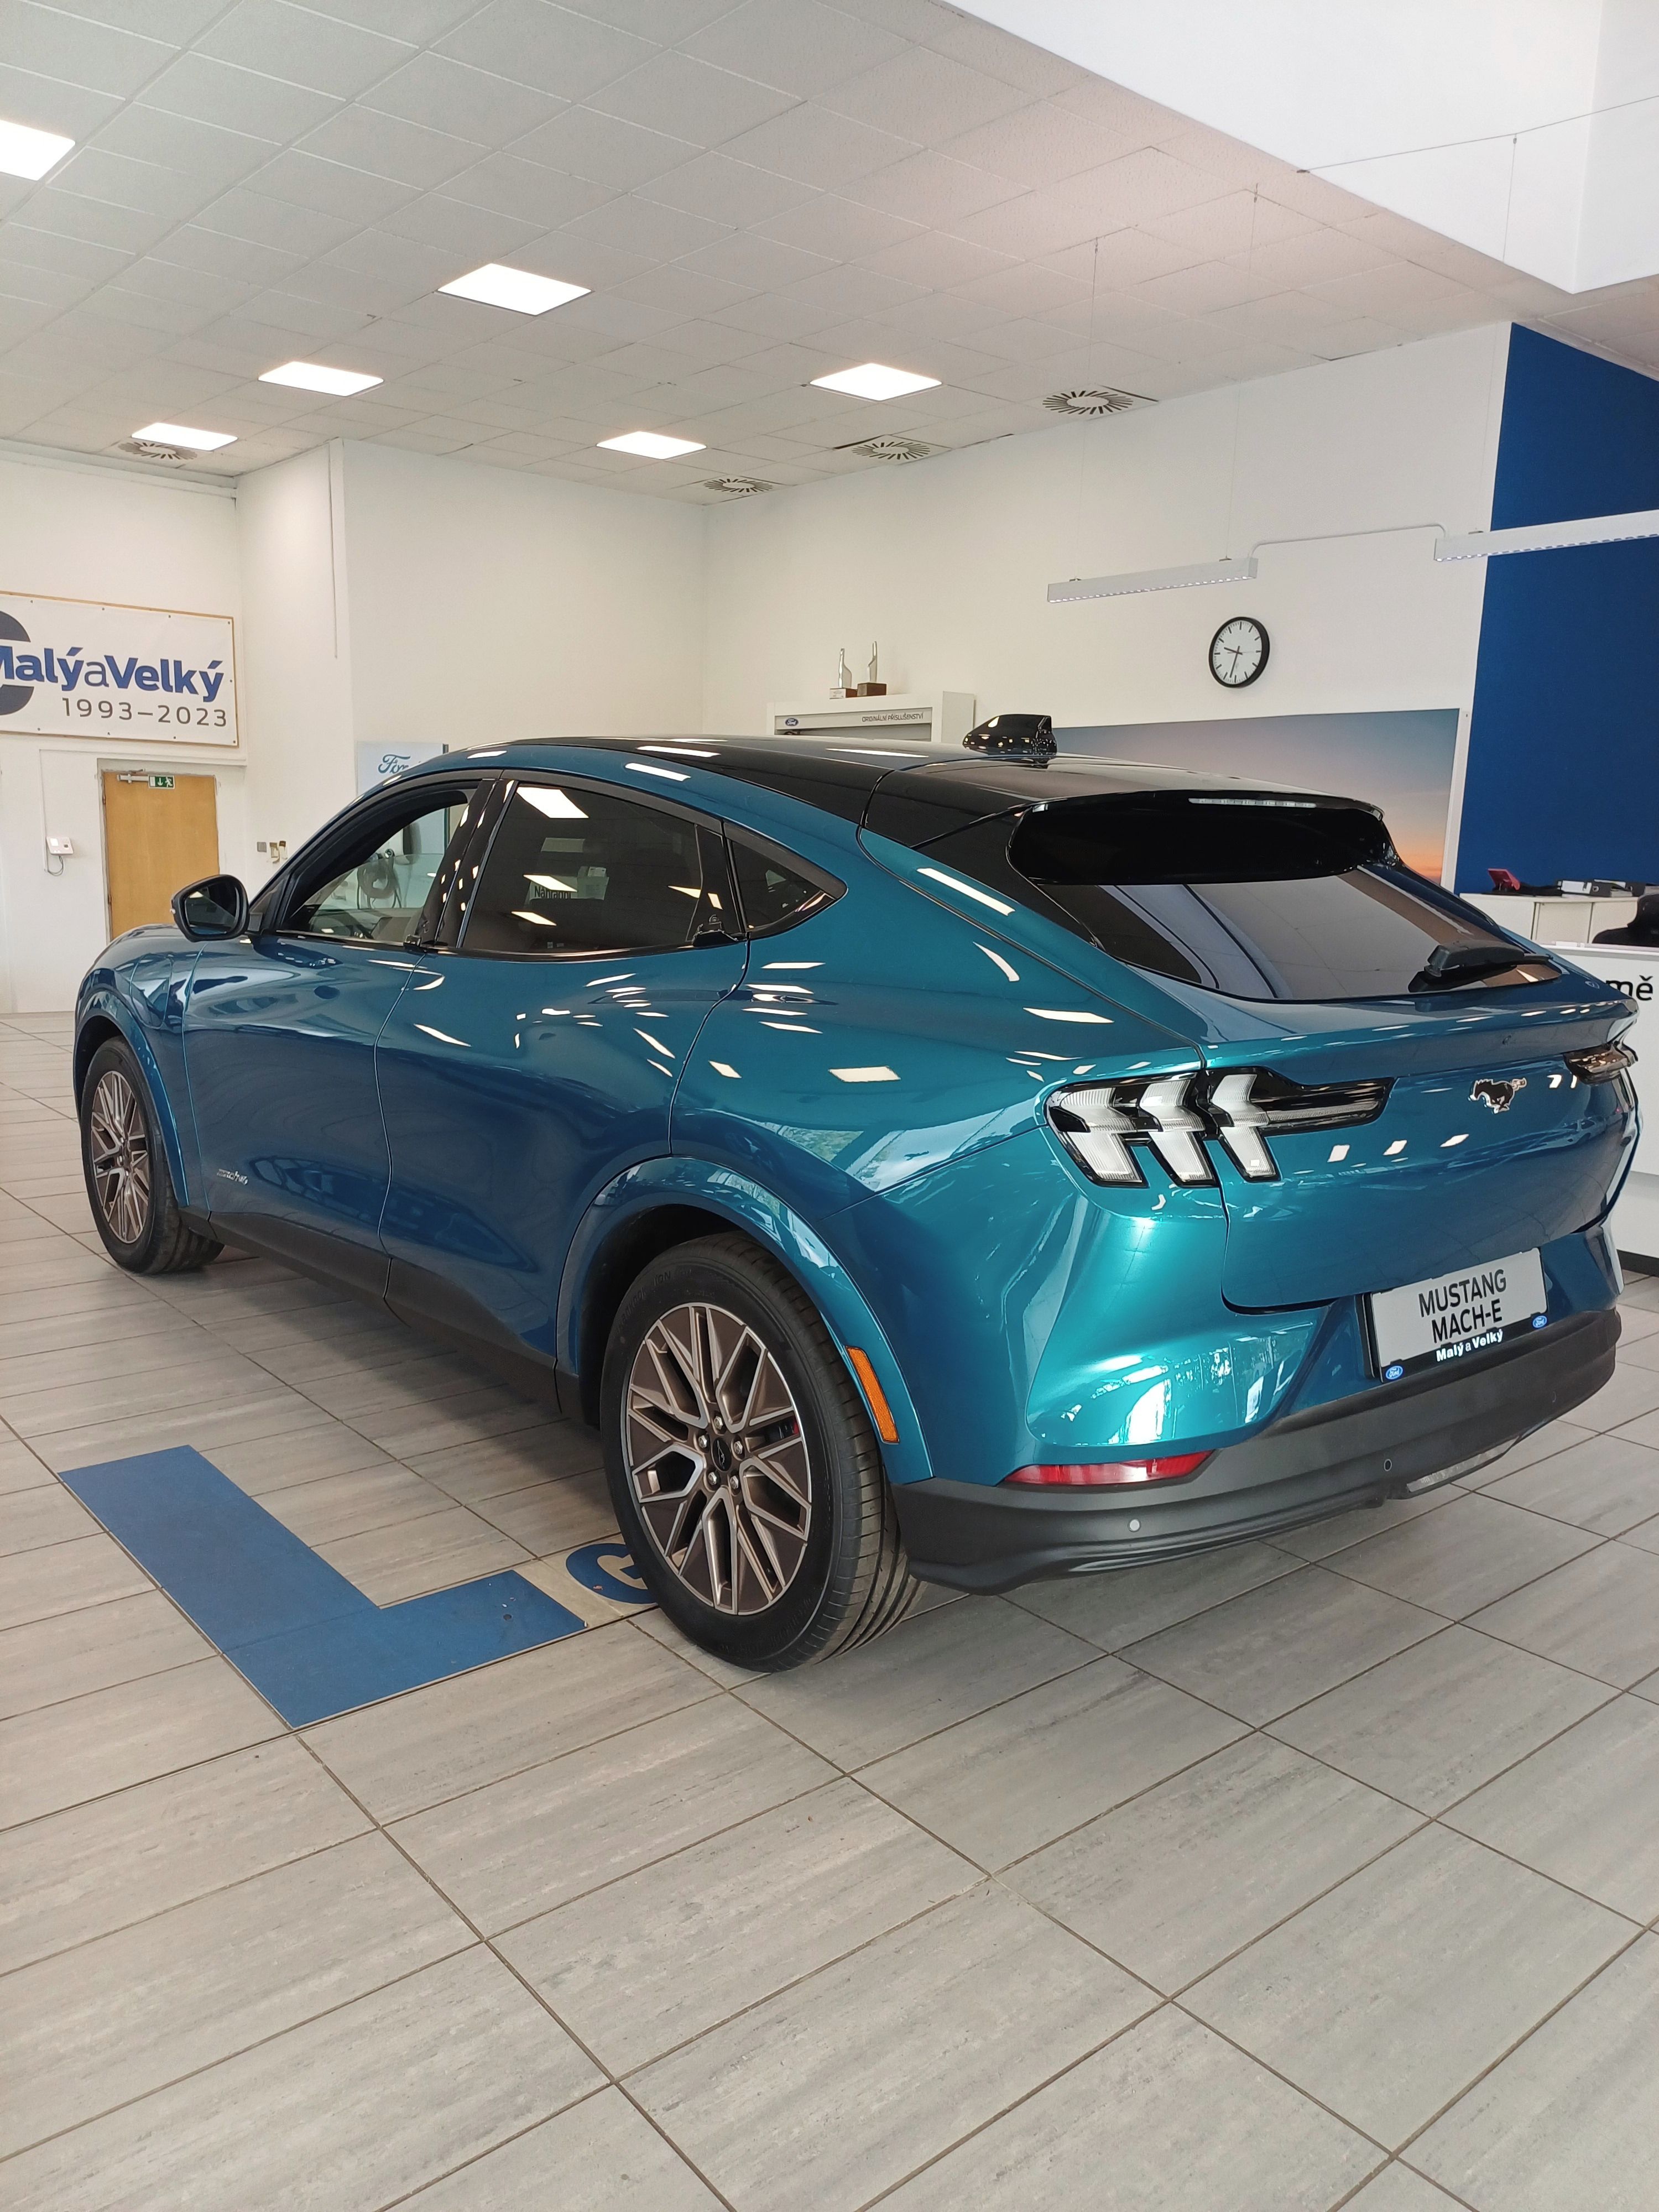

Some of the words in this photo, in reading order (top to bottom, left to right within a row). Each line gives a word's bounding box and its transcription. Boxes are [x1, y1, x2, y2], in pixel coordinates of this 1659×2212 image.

[62, 697, 227, 727] 1993–2023
[1418, 1269, 1507, 1318] MUSTANG
[1431, 1298, 1503, 1344] MACH-E
[1436, 1342, 1464, 1362] Malý
[1472, 1328, 1504, 1349] Velký
